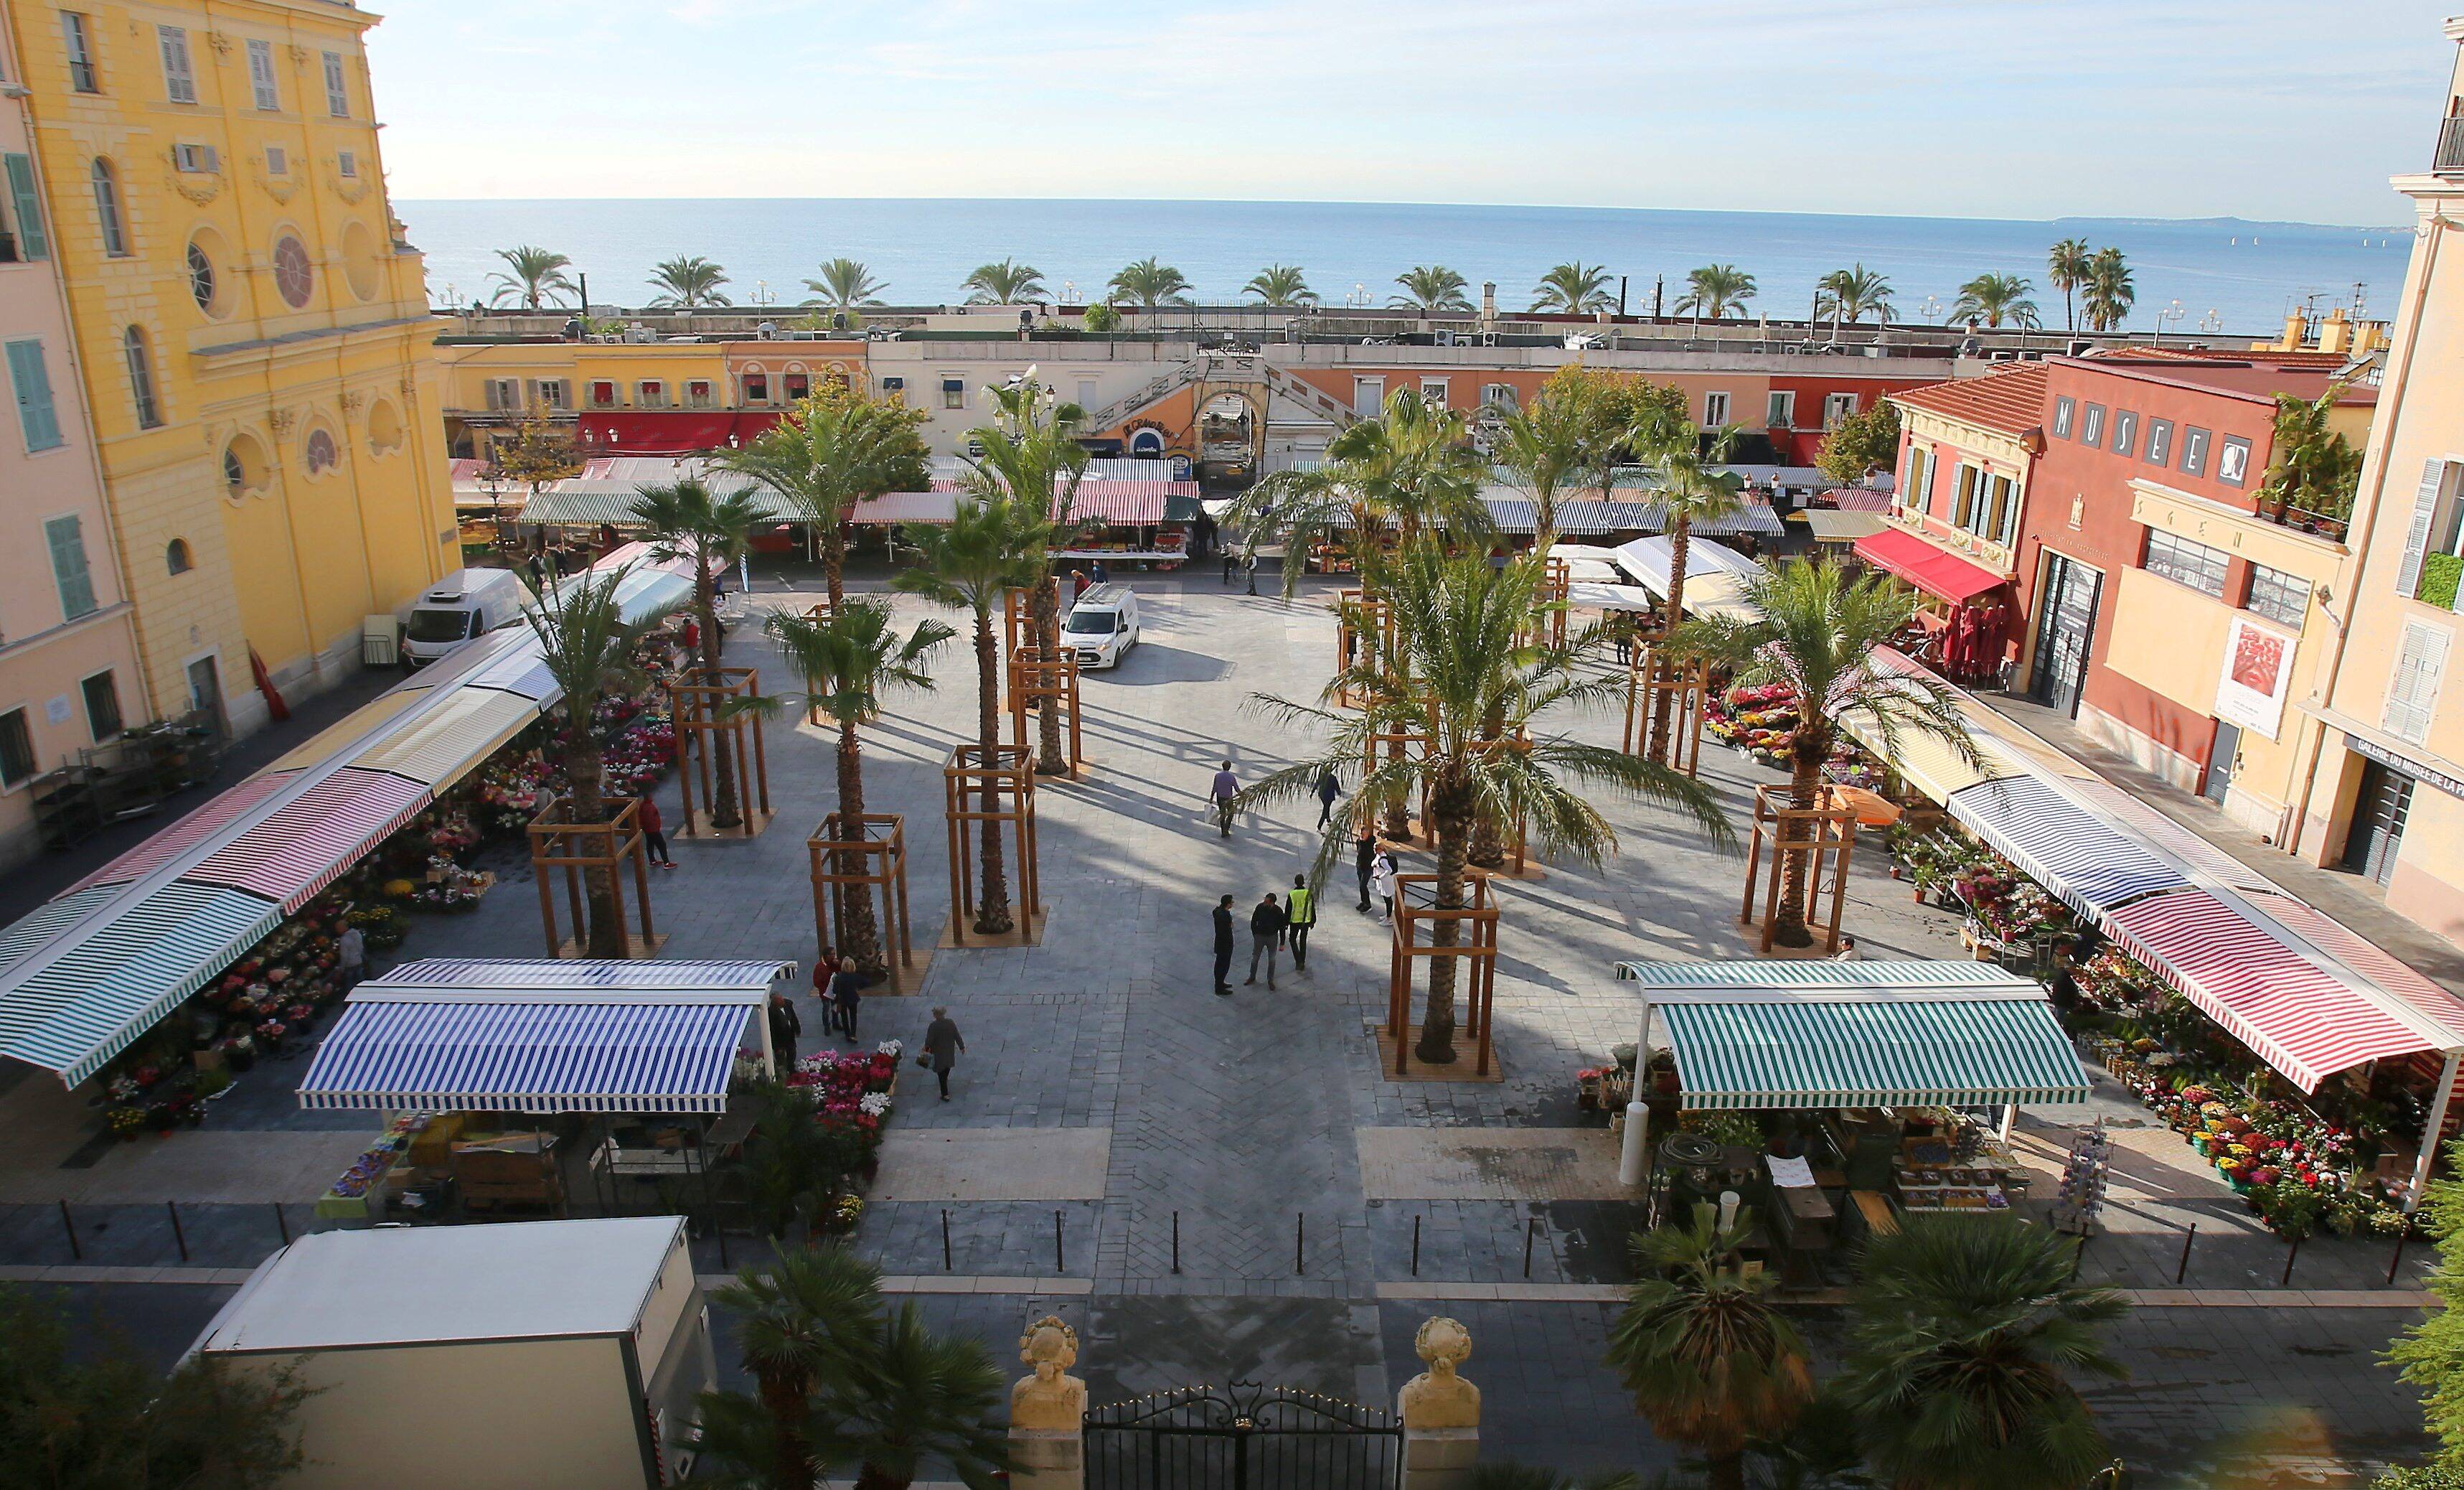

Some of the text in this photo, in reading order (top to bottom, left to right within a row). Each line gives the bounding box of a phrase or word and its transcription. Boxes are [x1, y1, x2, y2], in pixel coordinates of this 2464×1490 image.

[2056, 402, 2201, 469] MUSEE
[2358, 739, 2389, 762] GALERIE
[2389, 753, 2403, 767] DU
[2402, 759, 2432, 781] MUSEE
[2430, 772, 2444, 787] DE
[2442, 777, 2455, 792] LA
